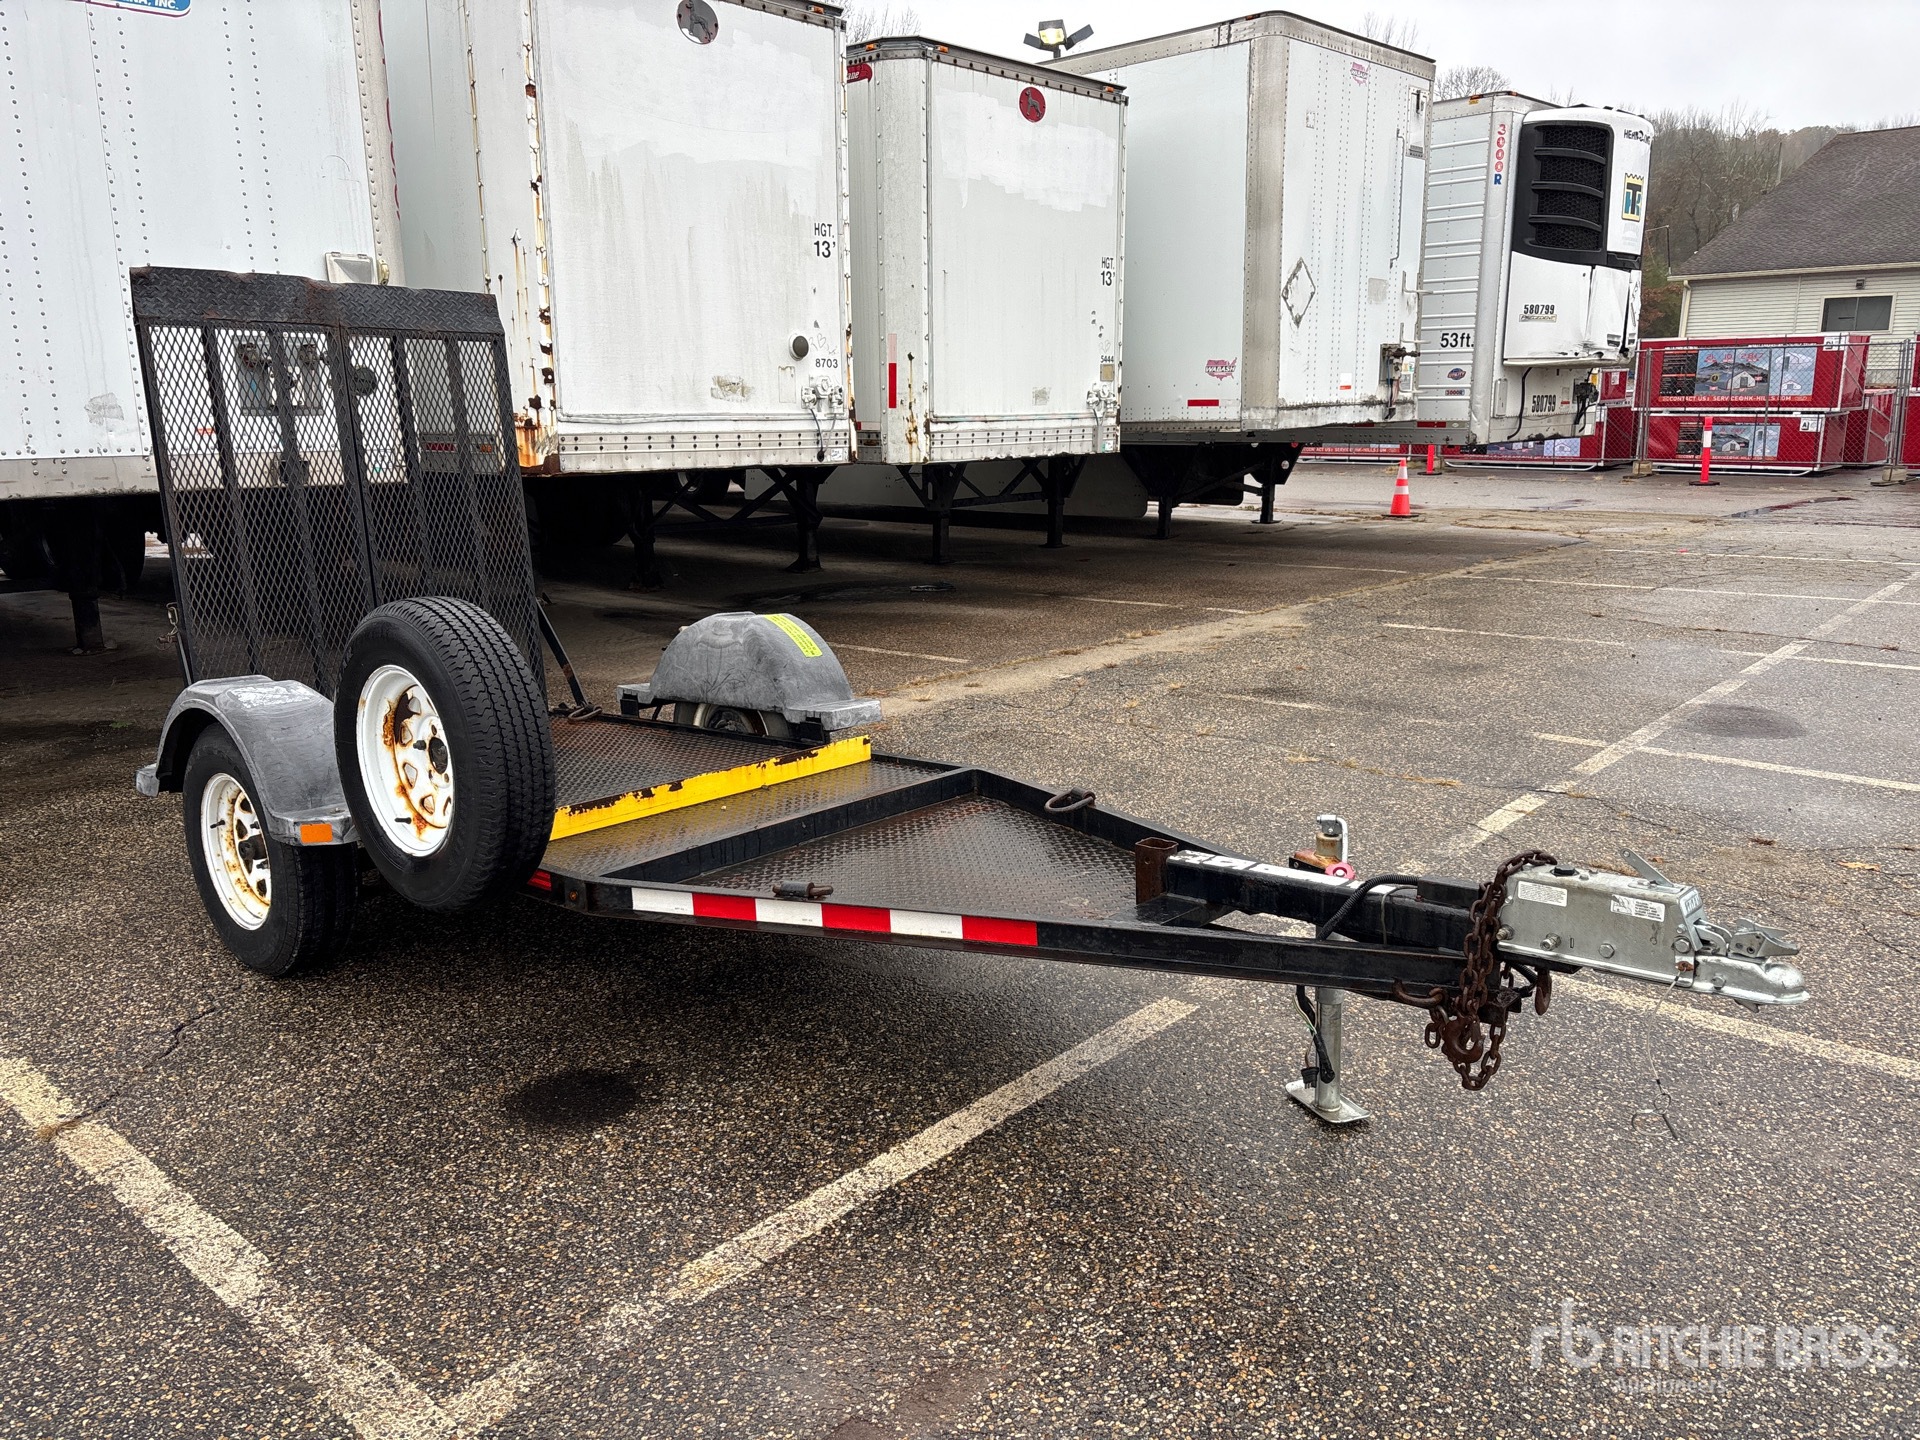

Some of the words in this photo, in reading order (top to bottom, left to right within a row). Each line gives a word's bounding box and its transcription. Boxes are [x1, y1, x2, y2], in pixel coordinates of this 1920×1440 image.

[154, 0, 179, 10] INC.
[1494, 123, 1506, 185] 3000R
[814, 223, 834, 239] HGT.
[813, 240, 836, 258] 13'
[1101, 257, 1115, 270] HGT.
[1523, 304, 1555, 315] 580799
[1440, 332, 1475, 348] 53ft.
[815, 358, 839, 369] 8703
[1100, 355, 1115, 363] 5444
[1531, 394, 1557, 413] 580799
